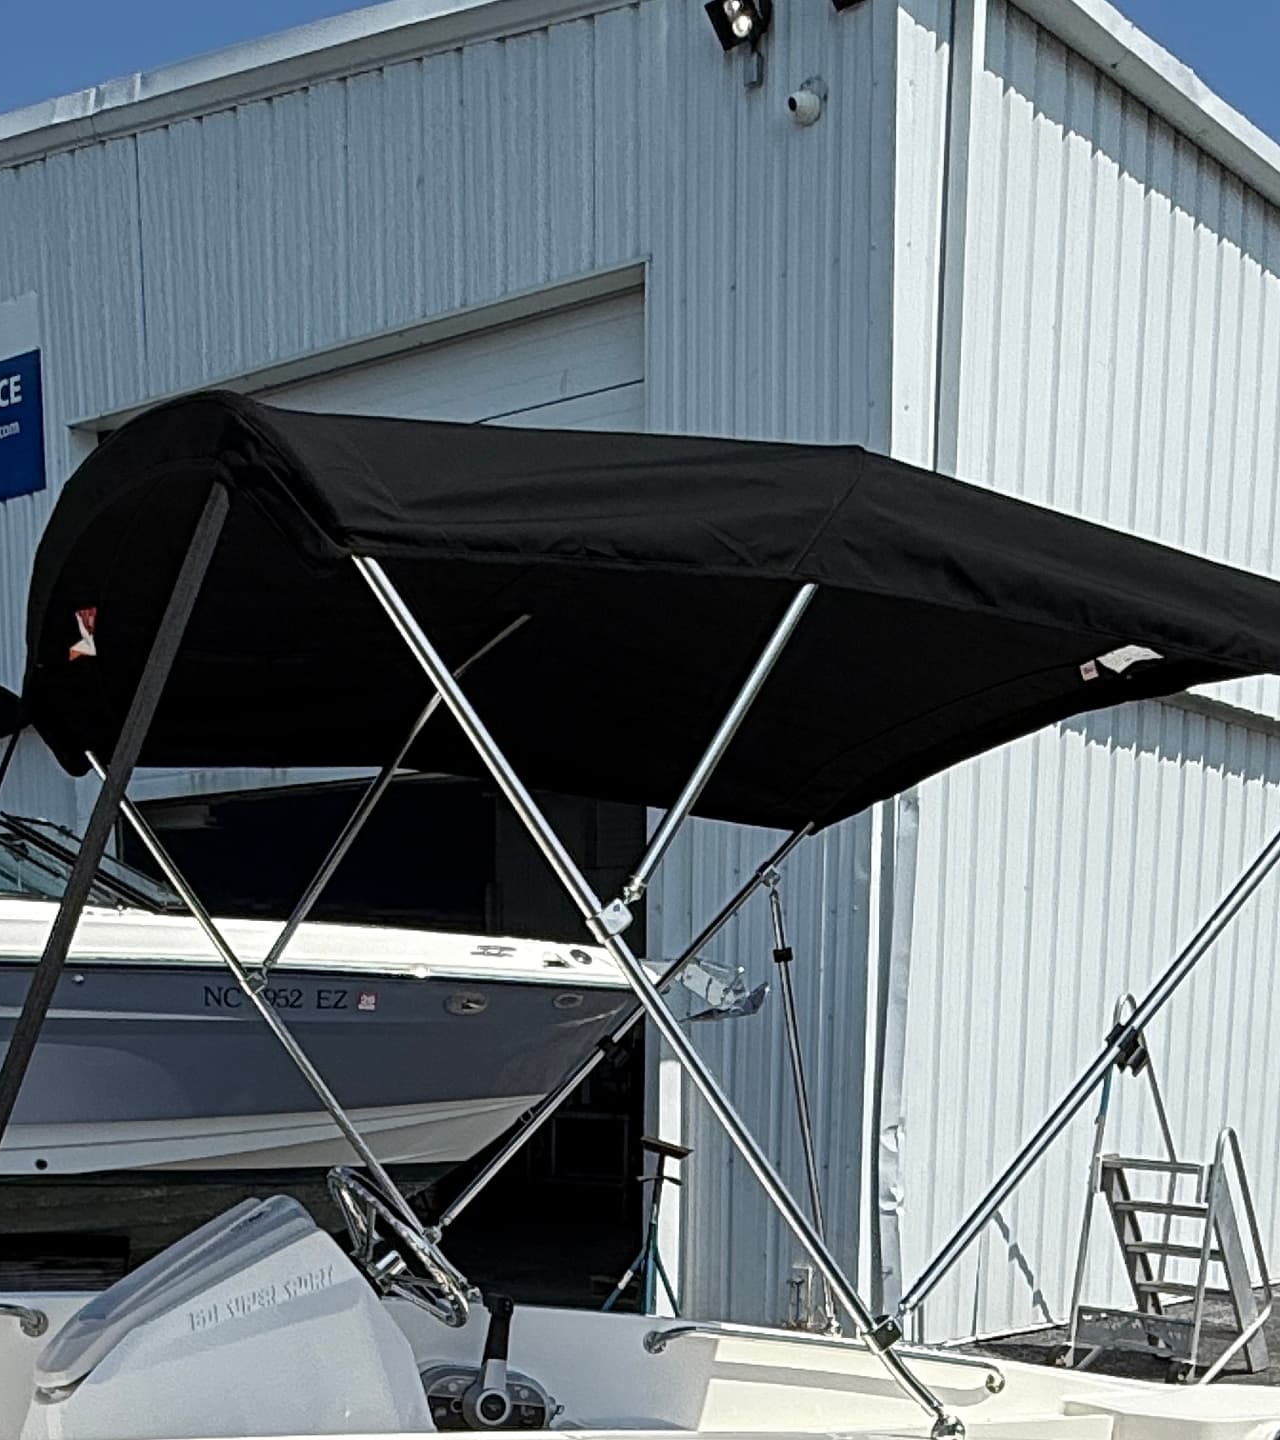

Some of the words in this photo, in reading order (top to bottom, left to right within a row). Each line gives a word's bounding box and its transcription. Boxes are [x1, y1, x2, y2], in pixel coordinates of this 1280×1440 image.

[204, 986, 241, 1008] NC
[256, 988, 303, 1009] 952
[316, 990, 348, 1009] EZ
